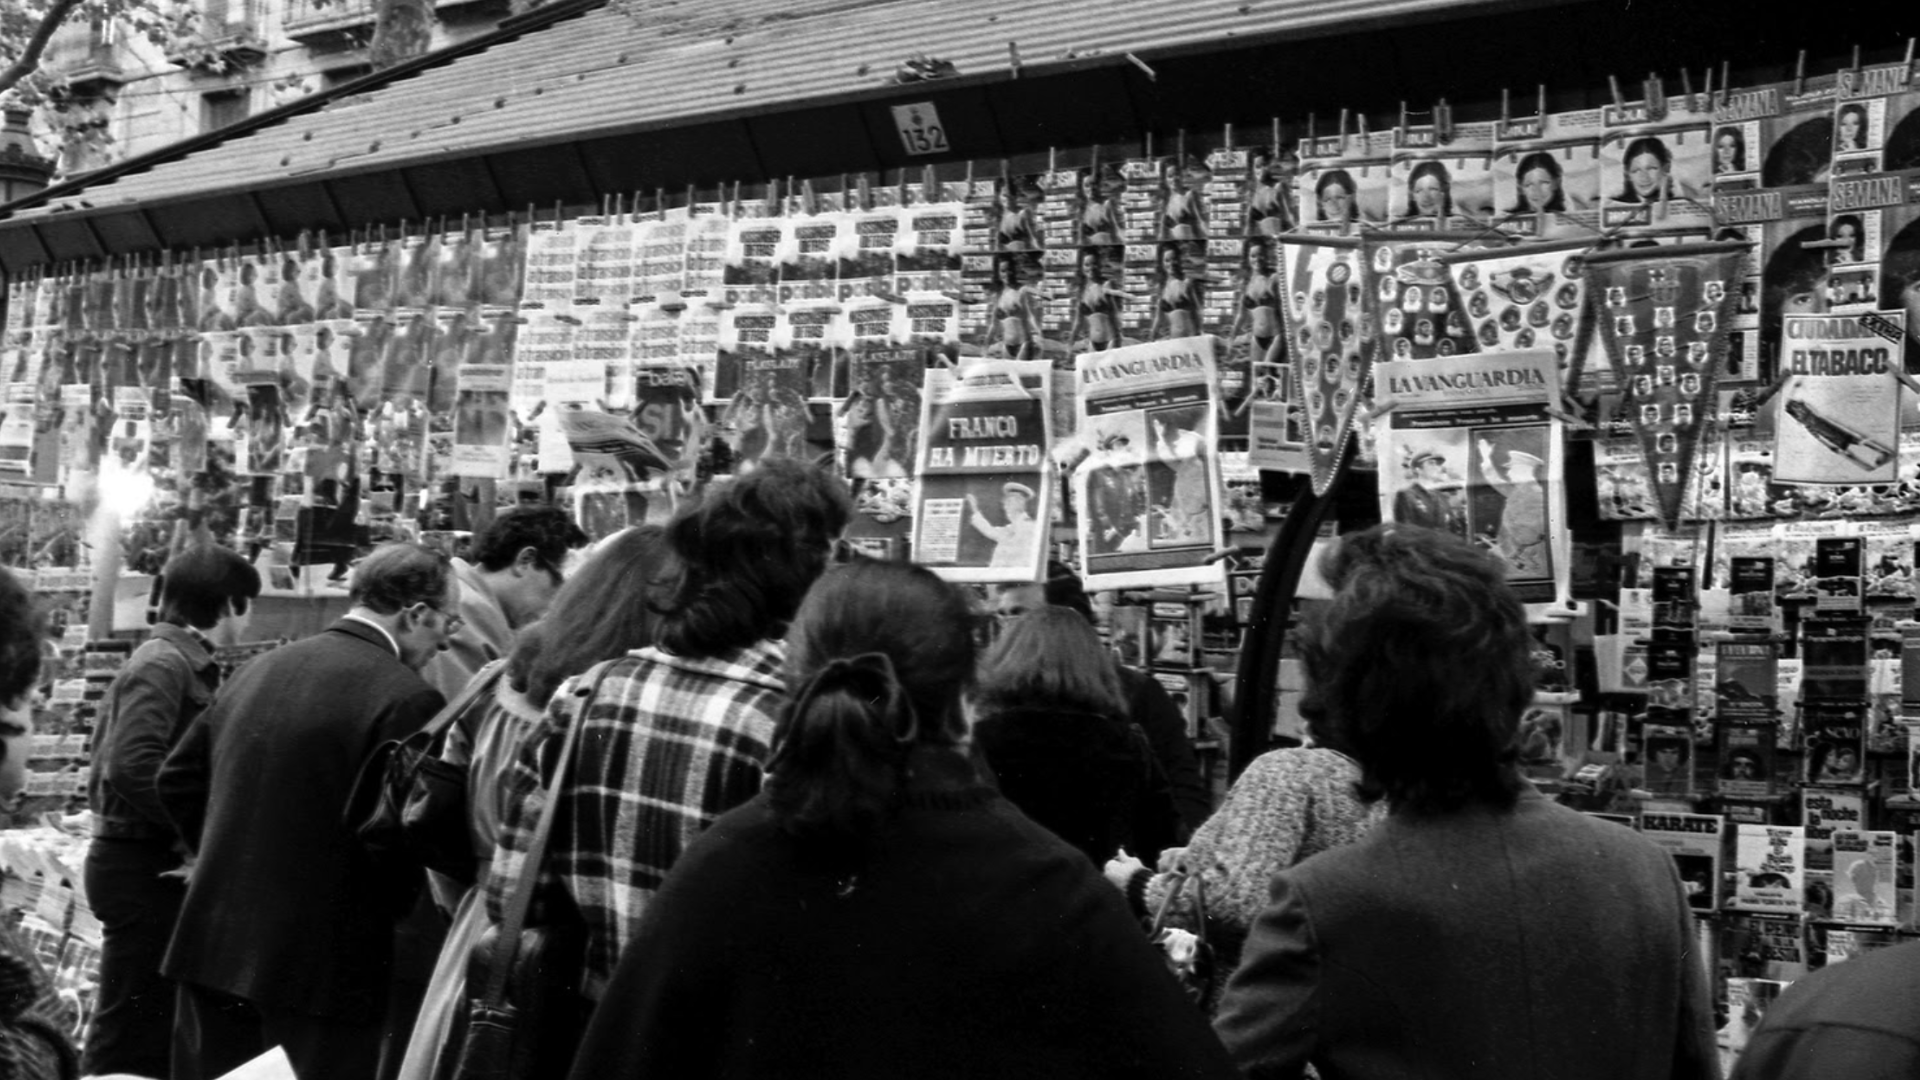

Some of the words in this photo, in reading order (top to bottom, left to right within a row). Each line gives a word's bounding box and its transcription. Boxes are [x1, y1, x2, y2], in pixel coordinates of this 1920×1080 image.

[1839, 66, 1912, 99] SMANA
[902, 126, 948, 151] 132
[1835, 177, 1903, 211] SEMANA
[1082, 367, 1099, 384] LA
[1100, 353, 1204, 382] VANGUARDIA
[1792, 350, 1808, 376] EL
[1809, 348, 1889, 376] TABACO
[1389, 376, 1411, 394] LA
[1413, 368, 1546, 392] VANGUARDIA
[949, 416, 1018, 440] FRANCO
[929, 447, 955, 468] HA
[962, 444, 1040, 468] MUERTO
[1806, 796, 1833, 810] esta
[1643, 815, 1718, 834] KARATE
[1808, 811, 1821, 826] la
[1821, 807, 1859, 821] noche
